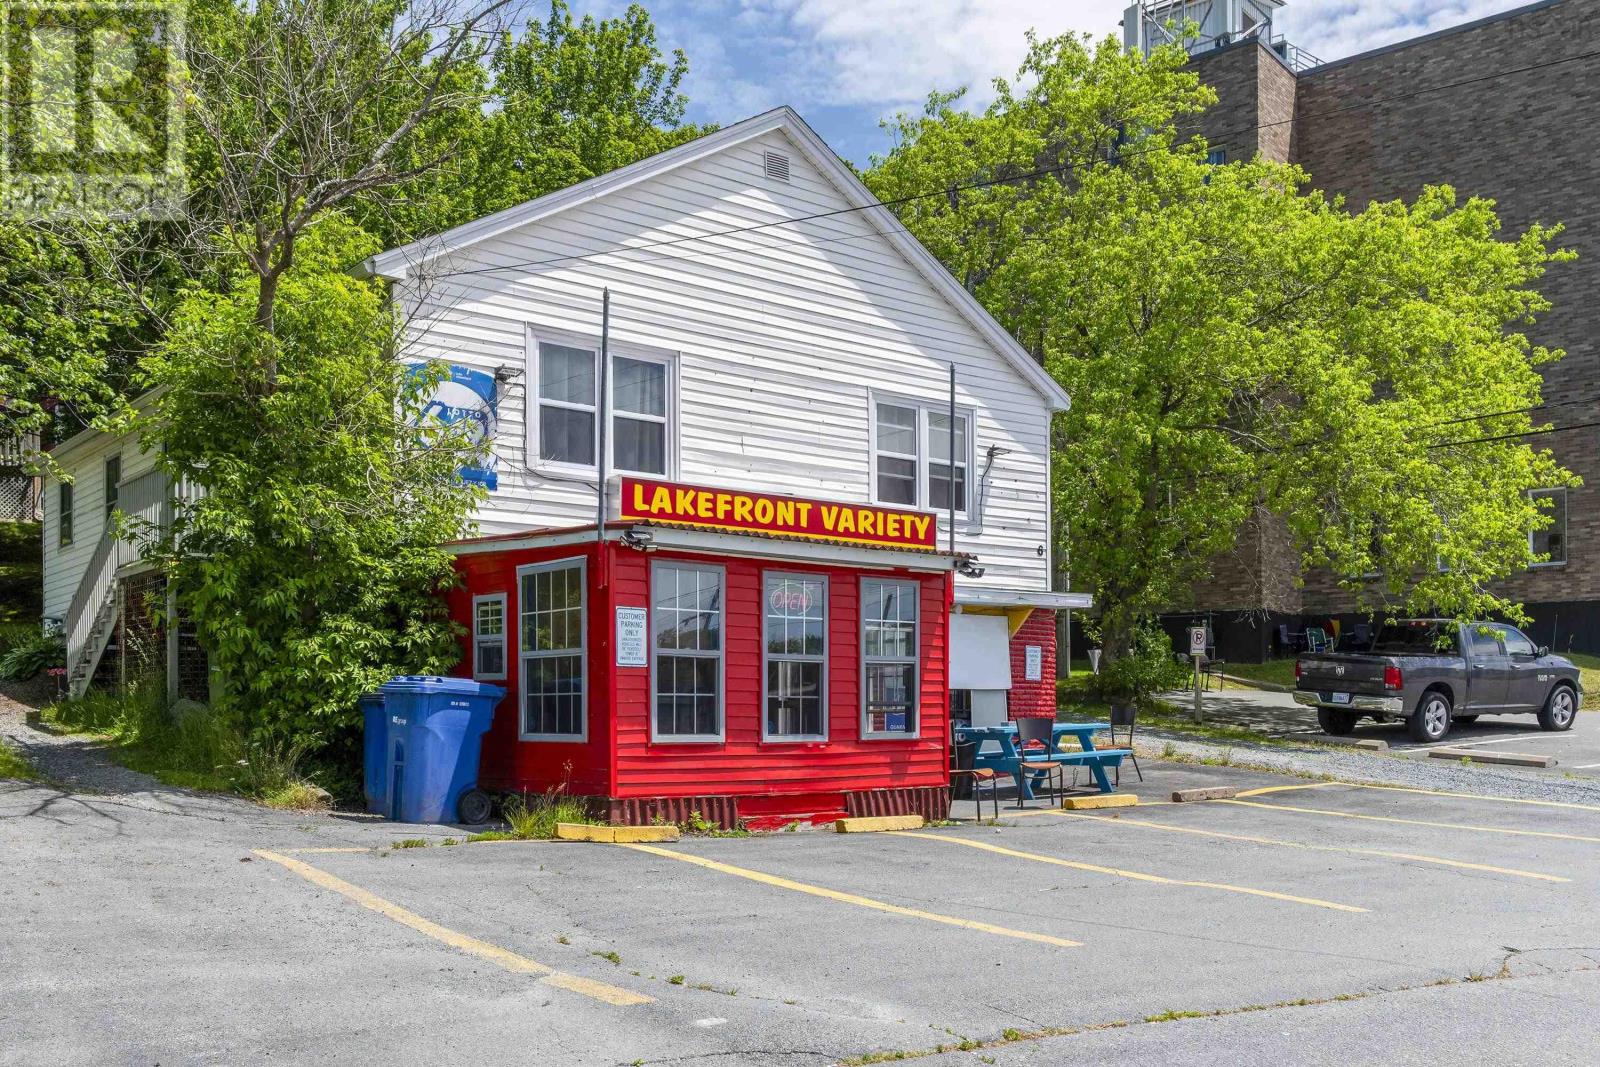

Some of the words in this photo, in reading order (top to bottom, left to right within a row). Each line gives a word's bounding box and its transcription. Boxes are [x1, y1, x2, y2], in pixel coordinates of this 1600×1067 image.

[633, 483, 812, 528] LAKEFRONT
[820, 505, 931, 540] VARIETY
[1037, 545, 1044, 556] 6
[772, 591, 809, 610] OPEN
[618, 612, 645, 620] CUSTOMER
